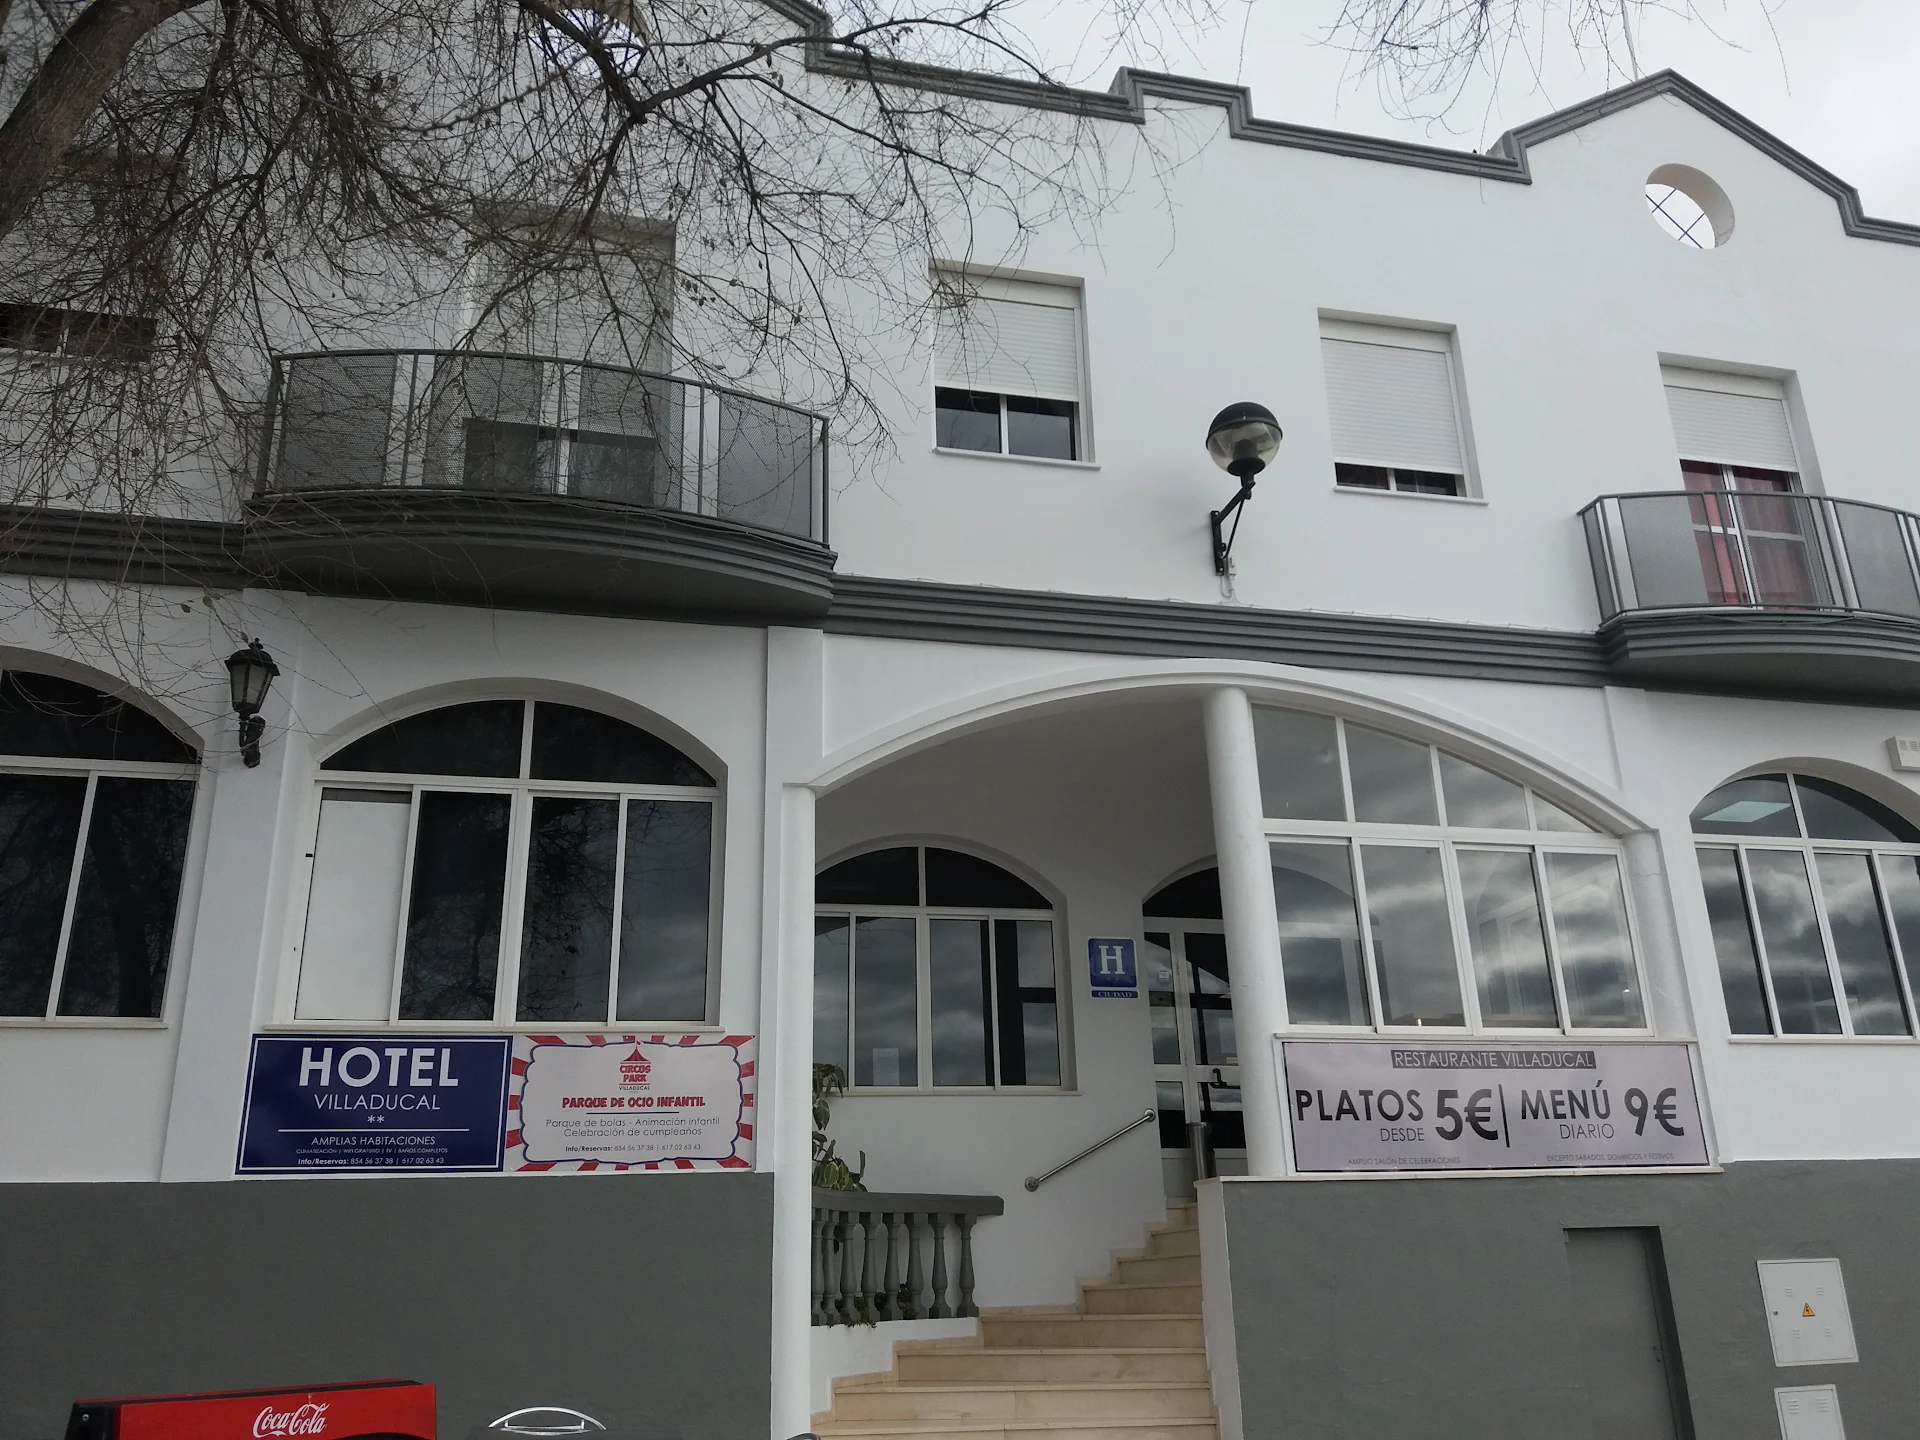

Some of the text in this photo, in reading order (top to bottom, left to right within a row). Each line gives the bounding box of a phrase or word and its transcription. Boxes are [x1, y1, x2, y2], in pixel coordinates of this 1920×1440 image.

[1098, 946, 1125, 974] H
[299, 1046, 459, 1088] HOTEL
[1394, 1052, 1594, 1068] RESTAURANTE VILLADUCAL
[620, 1065, 651, 1074] CIRCUS
[623, 1074, 646, 1082] PARK
[314, 1094, 441, 1110] VILLADUCAL
[562, 1096, 706, 1108] PARQUE DE OCIO INFANTIL
[1521, 1080, 1684, 1137] MENÚ 9€
[1296, 1088, 1498, 1140] PLATOS 5€
[546, 1119, 581, 1128] Parque
[584, 1118, 597, 1127] de
[600, 1118, 626, 1127] bolas
[634, 1117, 686, 1126] Animación
[688, 1116, 720, 1126] infantil
[564, 1126, 702, 1137] Celebración de cumpleaños
[1380, 1128, 1424, 1142] DESDE
[1560, 1124, 1614, 1139] DIARIO
[311, 1136, 436, 1146] AMPLIAS HABITACIONES
[1374, 1156, 1396, 1164] SALÓN
[1408, 1156, 1460, 1164] CELEBRACIONES
[253, 1403, 330, 1438] Coca-Cola
